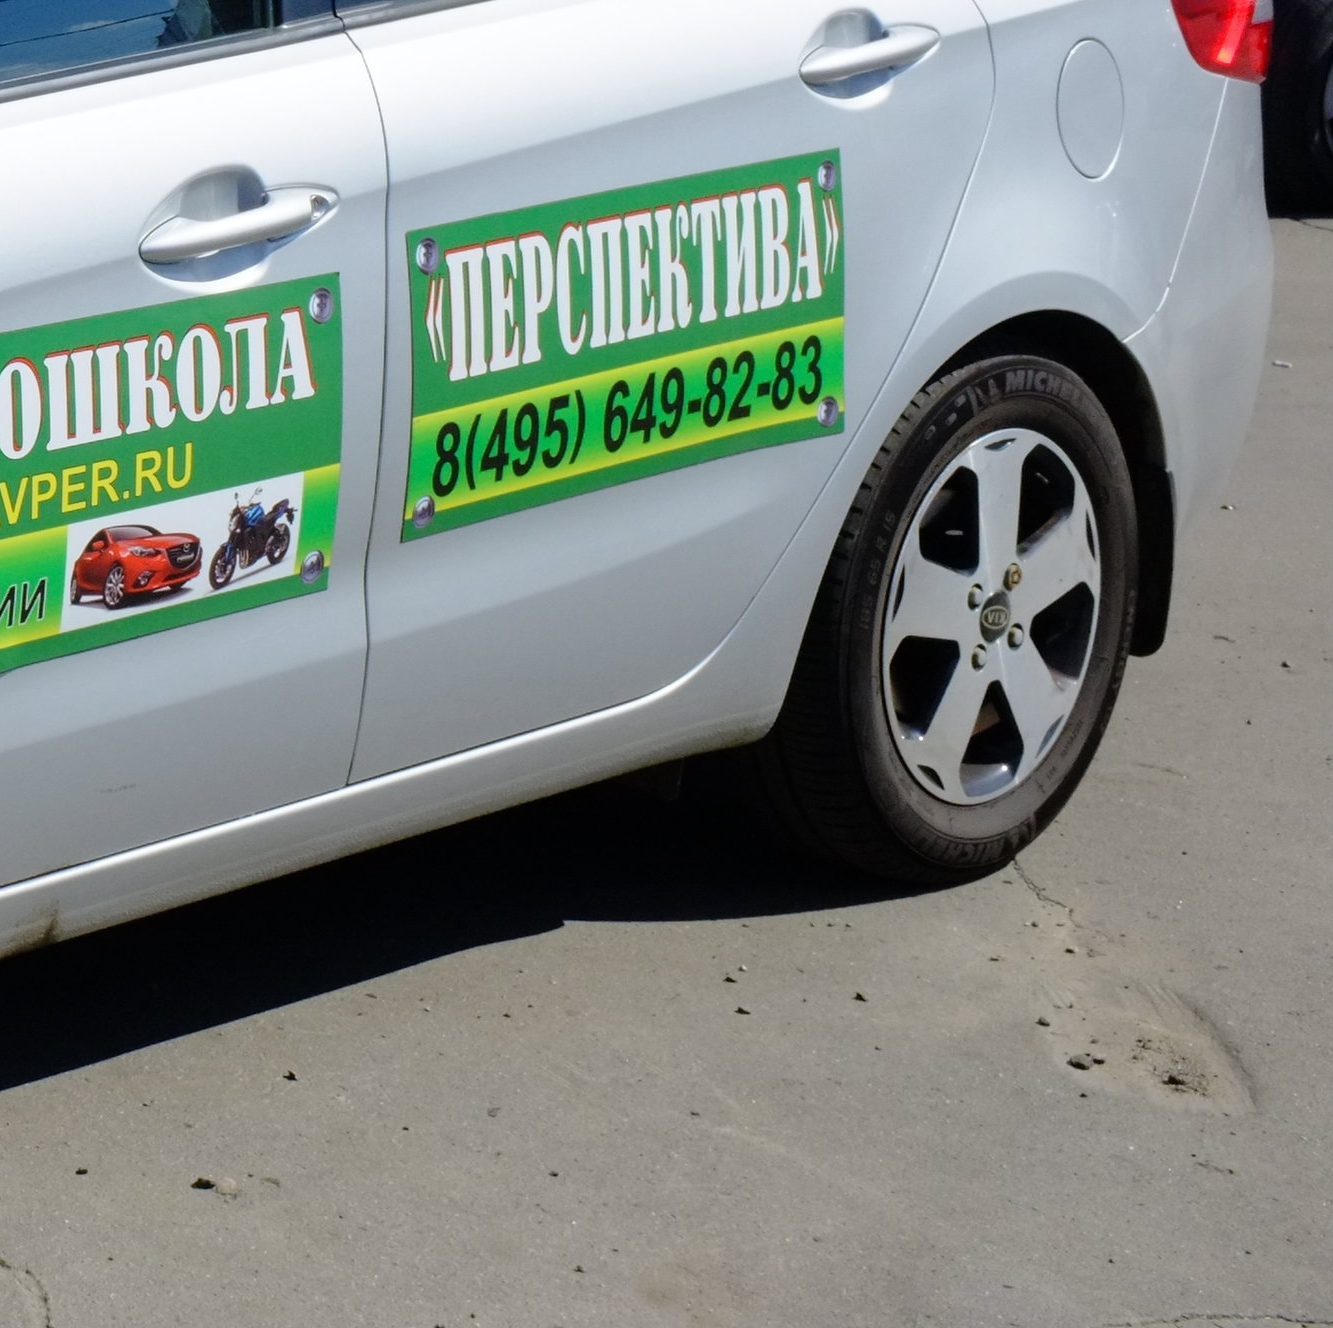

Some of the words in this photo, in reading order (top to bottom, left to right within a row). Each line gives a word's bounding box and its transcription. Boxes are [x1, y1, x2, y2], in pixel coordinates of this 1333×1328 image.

[425, 177, 838, 381] «ПЕРСПЕКТИВА»
[432, 389, 586, 497] 8(495)
[603, 335, 823, 453] 649-82-83
